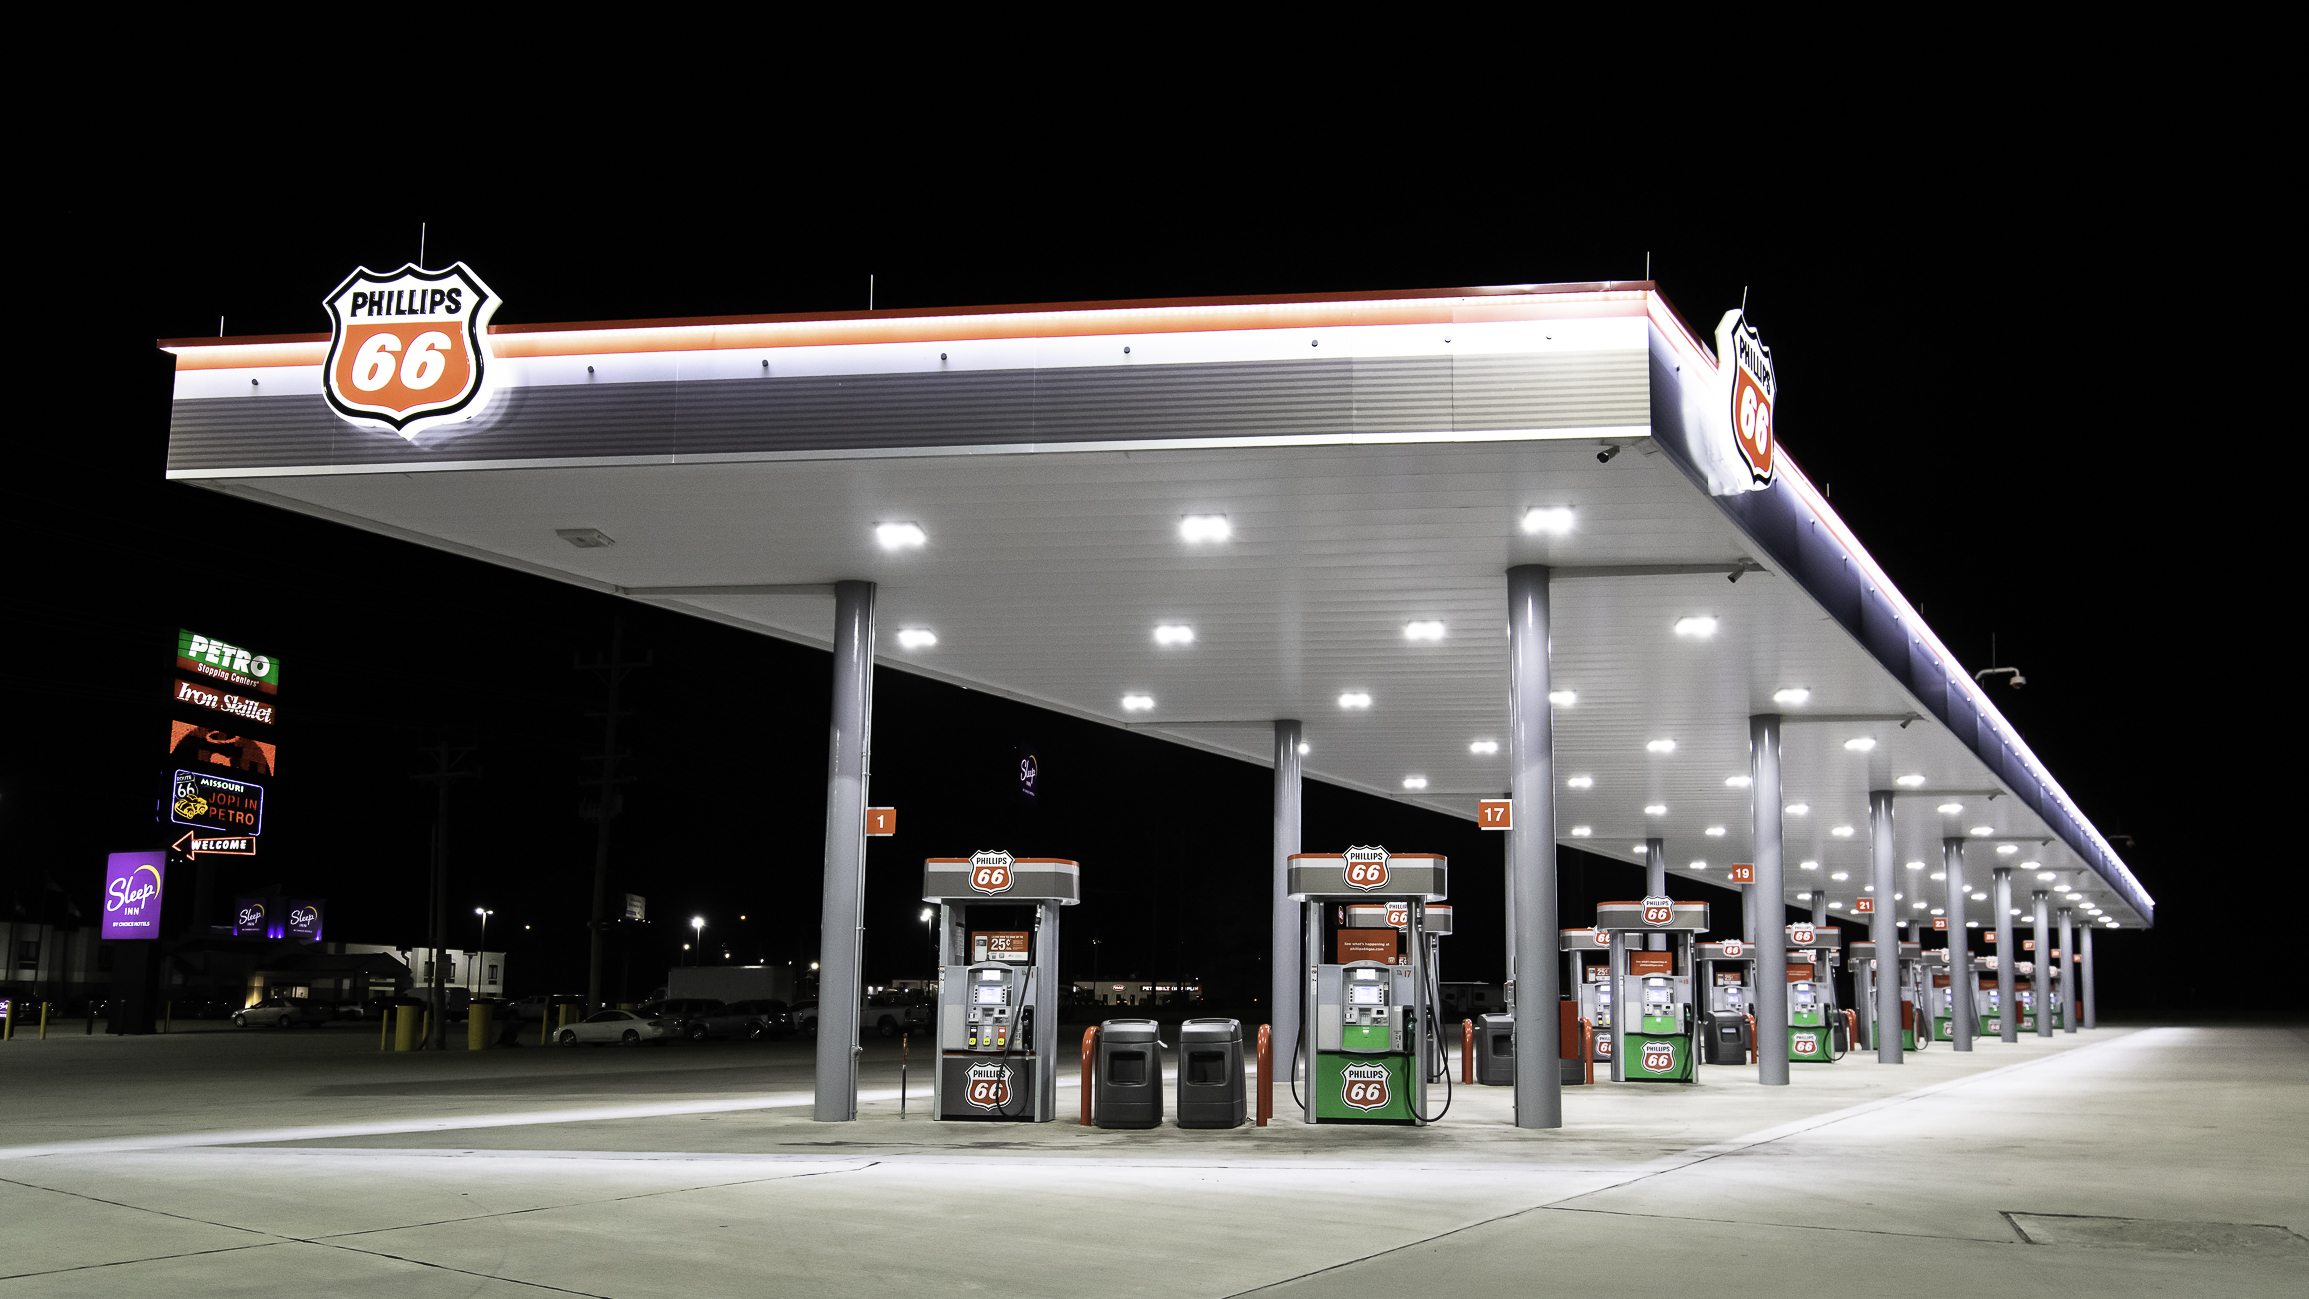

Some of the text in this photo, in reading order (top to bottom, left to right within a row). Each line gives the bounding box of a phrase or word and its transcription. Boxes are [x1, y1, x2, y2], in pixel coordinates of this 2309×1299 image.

[351, 287, 462, 317] PHILLIPS
[351, 330, 452, 392] 66
[1739, 334, 1771, 396] PHILLIPS
[1740, 385, 1770, 455] 66
[188, 634, 270, 677] PETRO
[197, 663, 230, 680] Stopping
[176, 681, 219, 709] Iron
[1020, 758, 1036, 785] Sleep
[177, 782, 195, 798] 66
[200, 778, 244, 793] MISSOURI
[209, 806, 255, 826] PETRO
[877, 815, 885, 828] 1
[1484, 807, 1505, 822] 17
[191, 839, 247, 850] WELCOME
[976, 856, 1007, 865] PHILLIPS
[1350, 852, 1383, 861] PHILLIPS
[977, 868, 1004, 885] 66
[1351, 864, 1381, 880] 66
[1735, 868, 1750, 879] 19
[106, 875, 155, 912] Sleep
[124, 907, 140, 916] INN
[1860, 901, 1870, 910] 21
[238, 908, 262, 925] Sleep
[290, 909, 314, 925] Sleep
[1648, 909, 1668, 920] 66
[1936, 920, 1946, 928] 23
[1795, 931, 1811, 941] 66
[1404, 970, 1412, 978] 17
[1797, 1042, 1813, 1051] 66
[1648, 1055, 1669, 1067] 66
[973, 1069, 1006, 1079] PHILLIPS
[1348, 1069, 1383, 1079] PHILLIPS
[974, 1082, 1004, 1100] 66
[1350, 1085, 1382, 1101] 66
